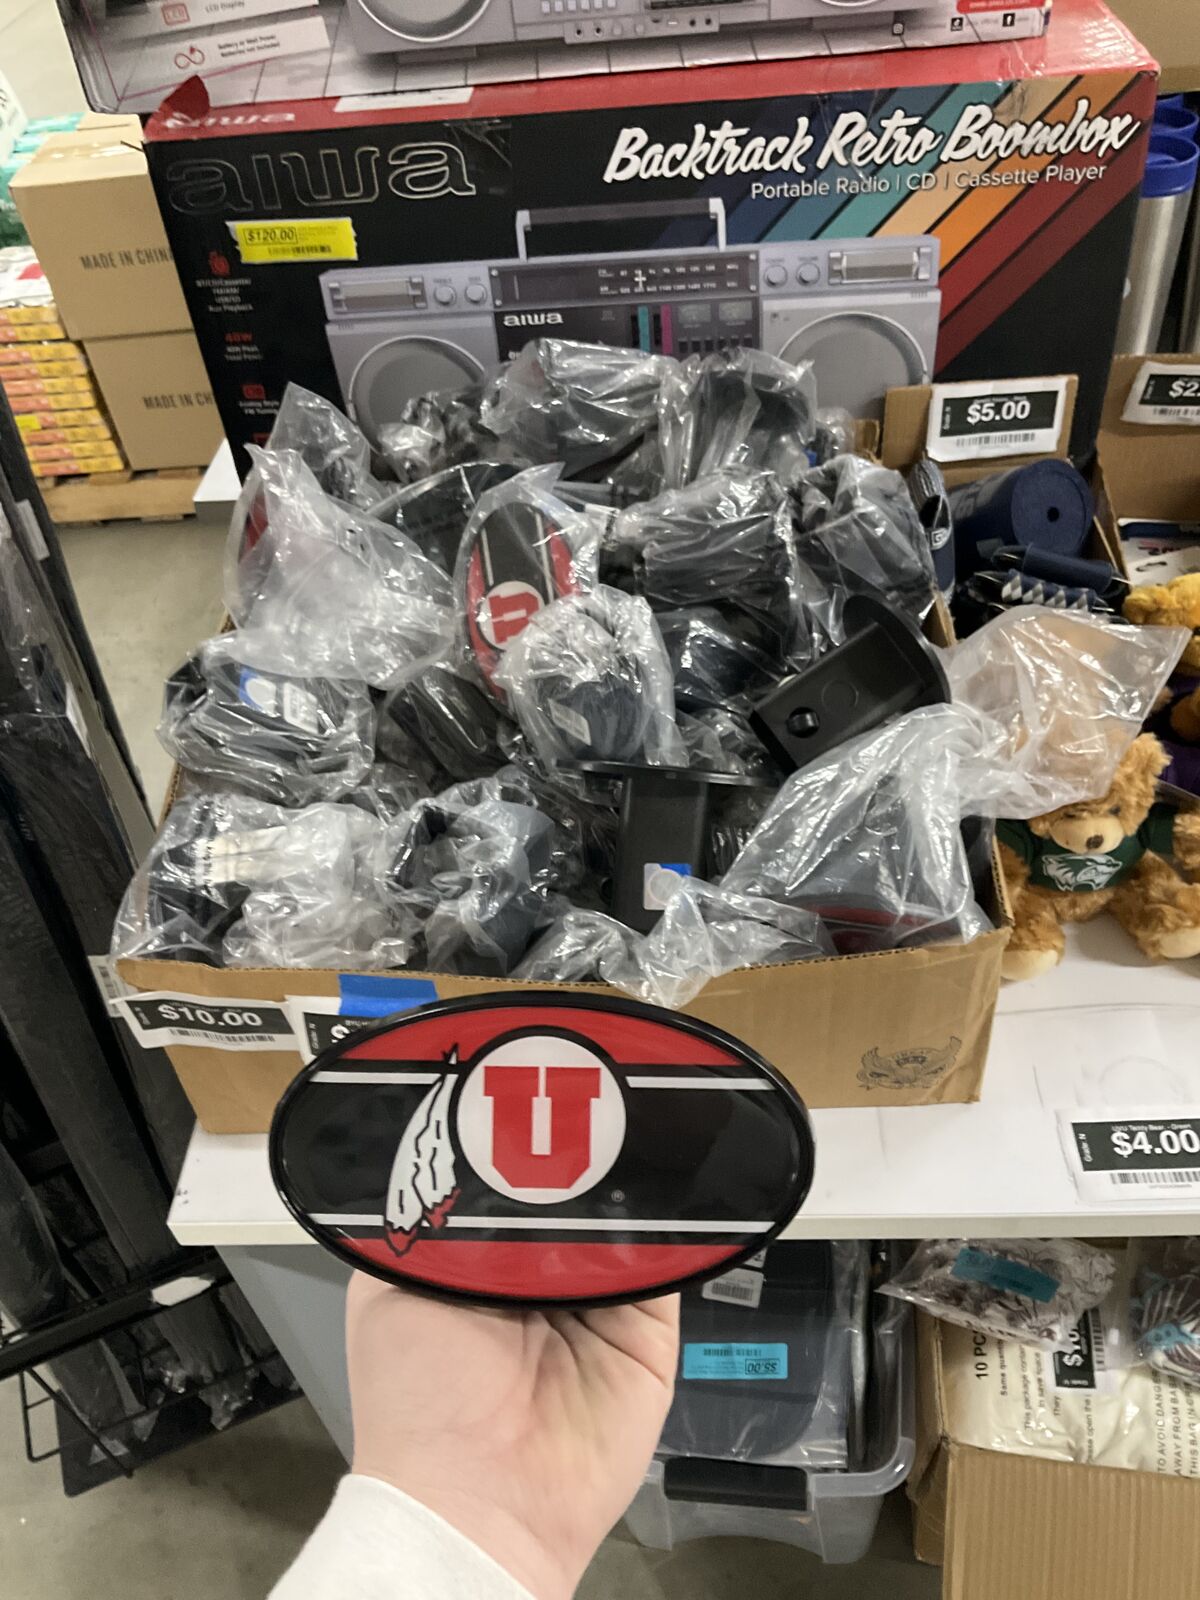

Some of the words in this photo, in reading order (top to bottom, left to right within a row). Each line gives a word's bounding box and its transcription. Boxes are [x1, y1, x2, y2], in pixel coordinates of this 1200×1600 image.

[603, 115, 814, 184] Backtrack
[816, 108, 943, 170] Retro
[939, 98, 1141, 163] Boombox
[166, 141, 476, 217] aiwa
[751, 179, 830, 199] Portable
[836, 174, 890, 194] Radio
[906, 172, 936, 190] CD
[954, 168, 1040, 189] Cassette
[1045, 164, 1107, 186] Player
[246, 229, 295, 243] $120.00
[81, 252, 118, 270] MADE
[119, 250, 135, 266] IN
[503, 311, 564, 328] aiwa
[143, 394, 178, 410] MADE
[180, 392, 194, 408] IN
[966, 399, 1031, 426] $5.00
[157, 1003, 263, 1027] $10.00
[484, 1065, 602, 1190] U
[1110, 1128, 1200, 1159] $4.00
[972, 1329, 987, 1359] PC
[975, 1361, 989, 1381] 10
[1000, 1373, 1008, 1397] Same
[1086, 1414, 1096, 1434] open
[1170, 1406, 1182, 1442] FROM
[1158, 1458, 1167, 1473] TO
[1173, 1442, 1184, 1477] AWAY
[1189, 1449, 1199, 1475] THIS
